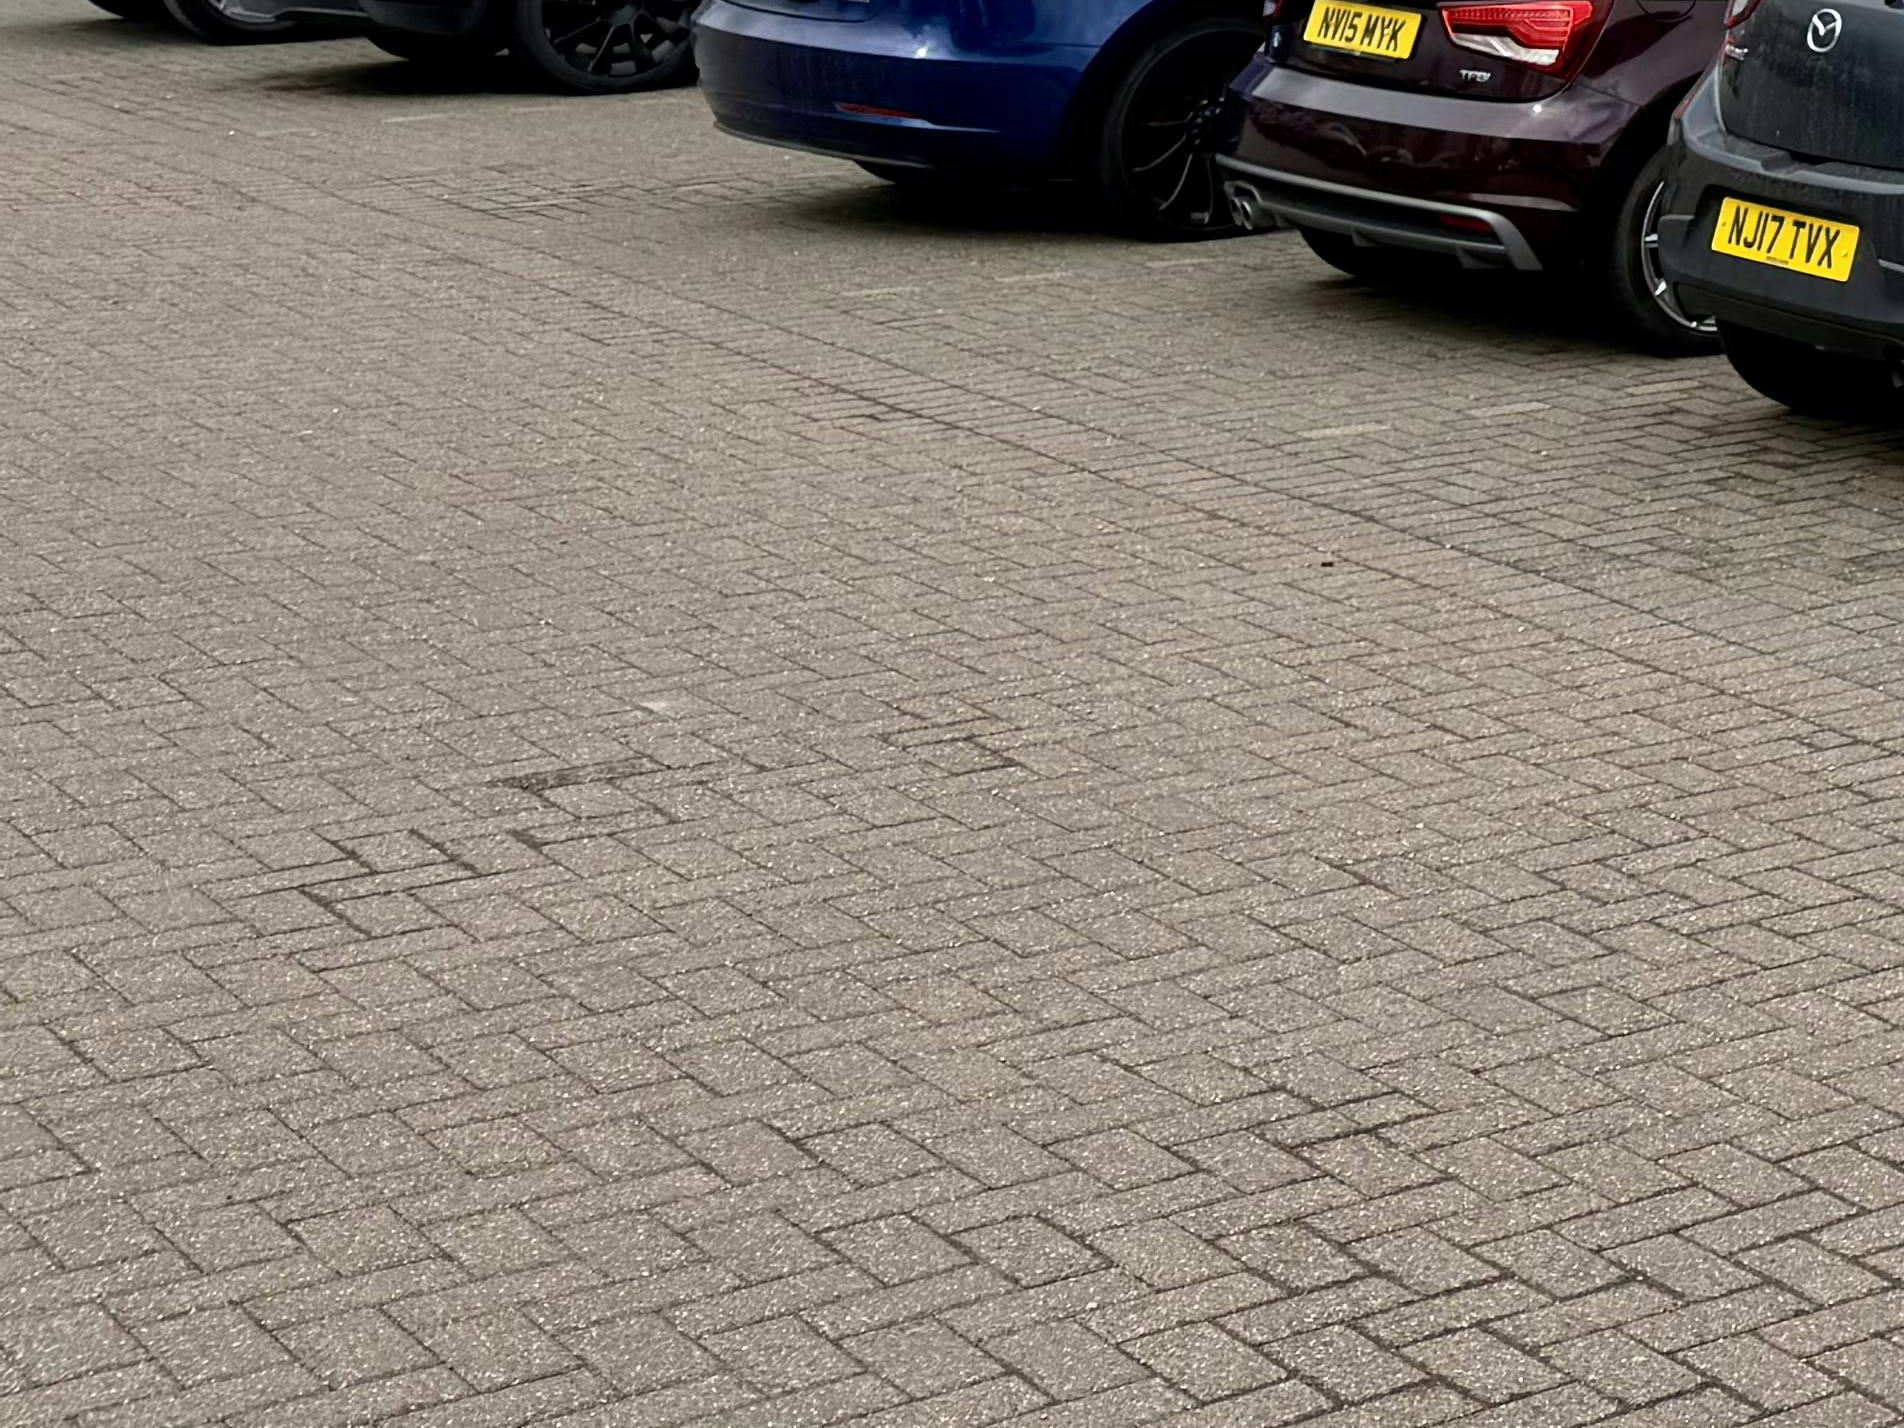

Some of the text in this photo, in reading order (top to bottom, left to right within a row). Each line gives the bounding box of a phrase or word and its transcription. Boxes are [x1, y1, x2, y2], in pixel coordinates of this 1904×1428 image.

[1317, 6, 1406, 52] NV15 MYK
[1728, 205, 1840, 269] NJ17 TVX
